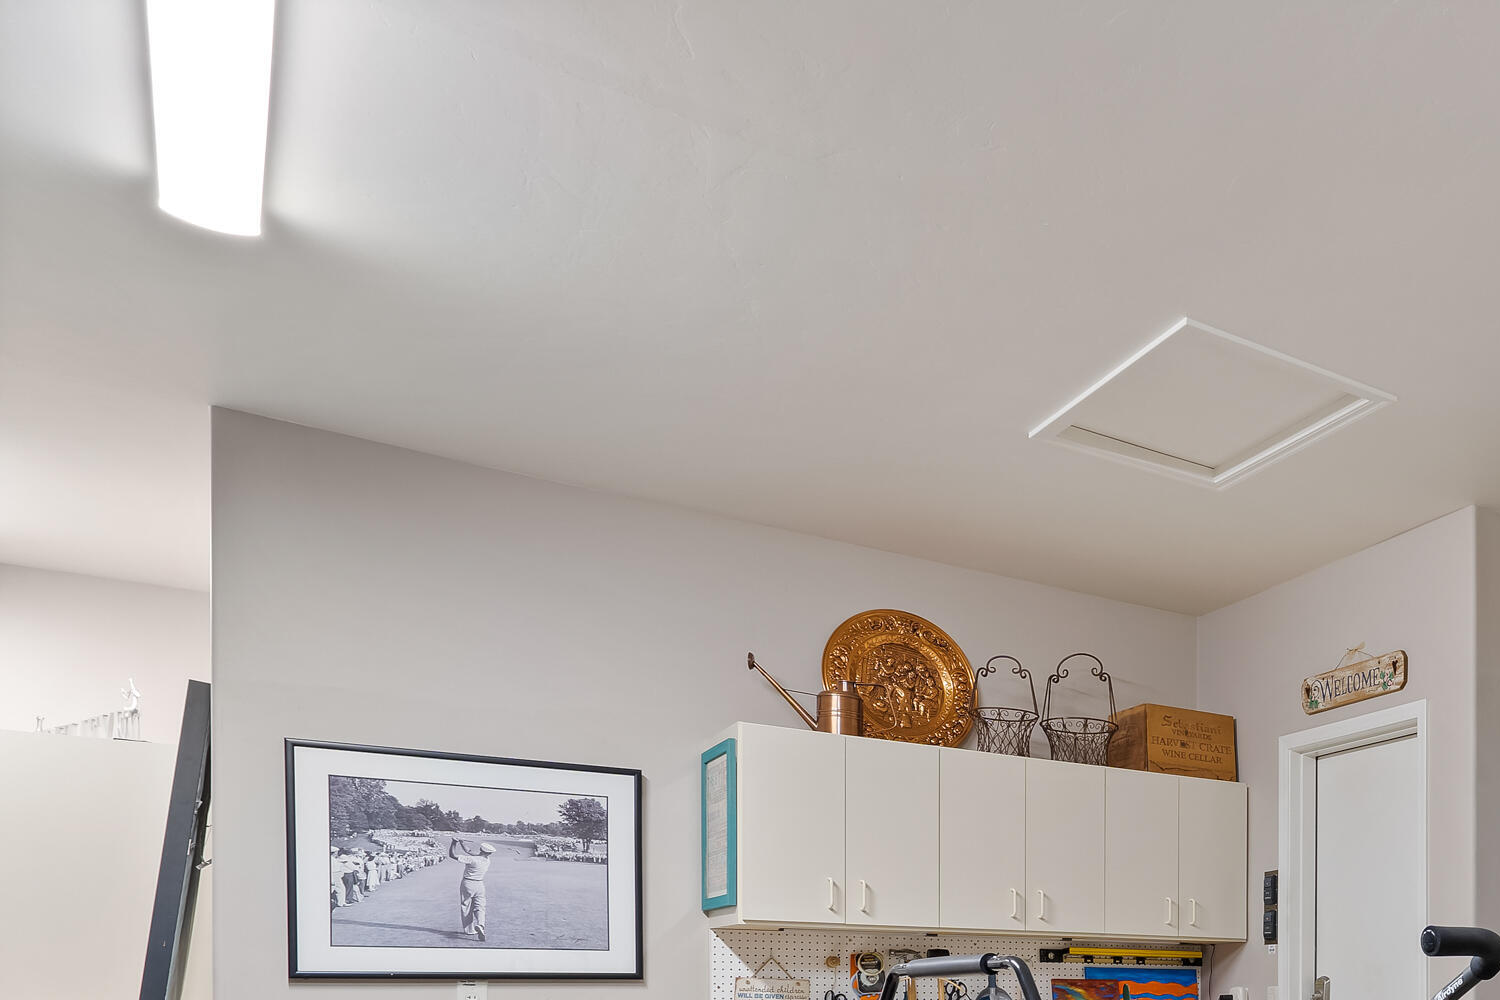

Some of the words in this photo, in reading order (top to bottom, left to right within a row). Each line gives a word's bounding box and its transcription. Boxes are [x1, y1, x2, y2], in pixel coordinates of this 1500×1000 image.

[1311, 667, 1380, 702] WELCOME
[1161, 748, 1187, 759] WINE
[1188, 752, 1223, 764] CELLAR
[1199, 742, 1232, 755] CRATE
